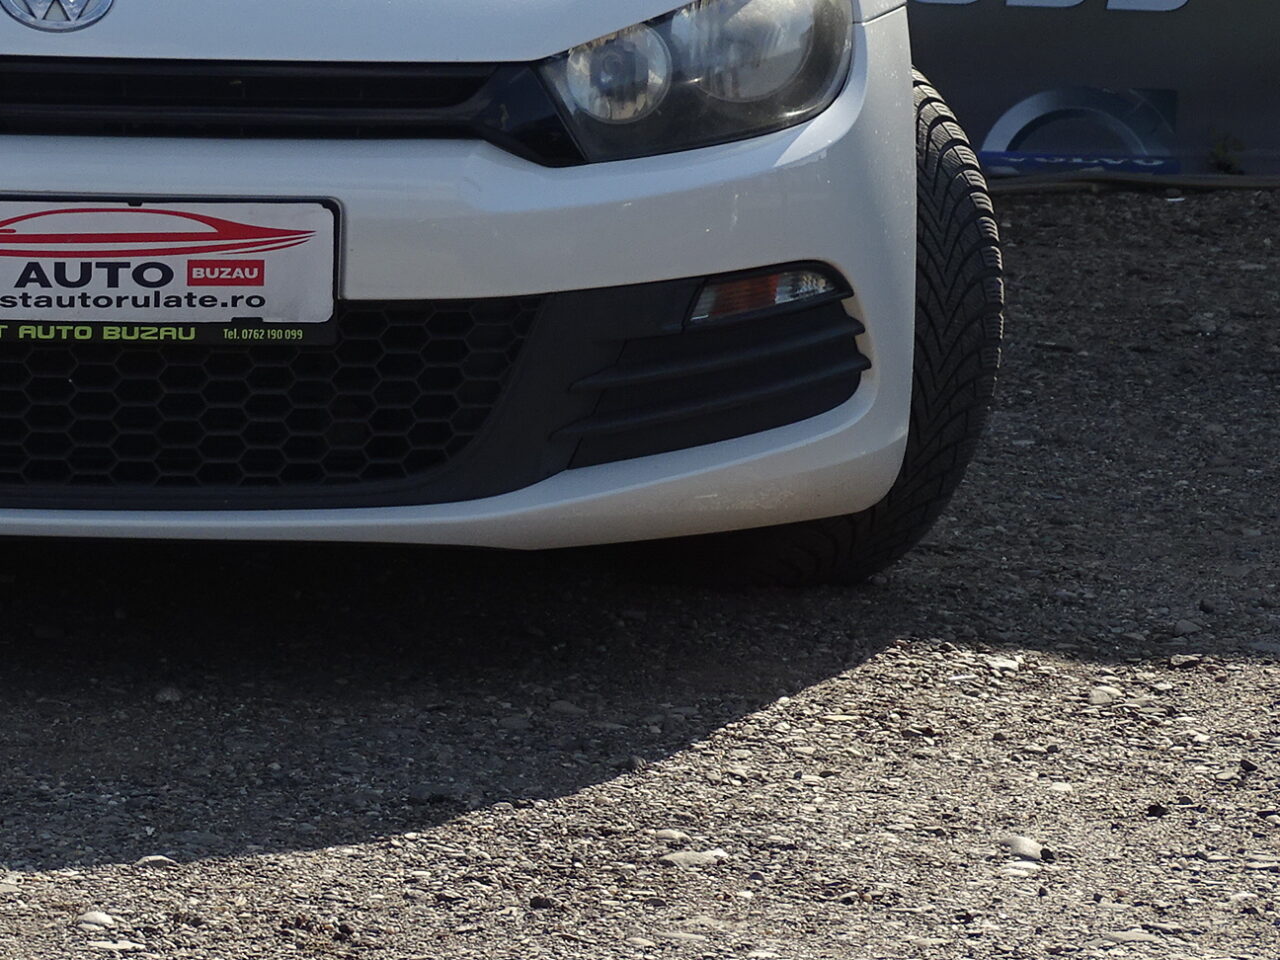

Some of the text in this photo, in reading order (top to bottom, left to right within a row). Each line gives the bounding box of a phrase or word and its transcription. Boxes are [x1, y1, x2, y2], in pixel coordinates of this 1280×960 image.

[14, 260, 175, 289] AUTO
[192, 266, 259, 281] BUZAU
[19, 325, 93, 340] AUTO
[103, 326, 196, 341] BUZAU
[223, 328, 303, 340] Tel. 0762 190 099
